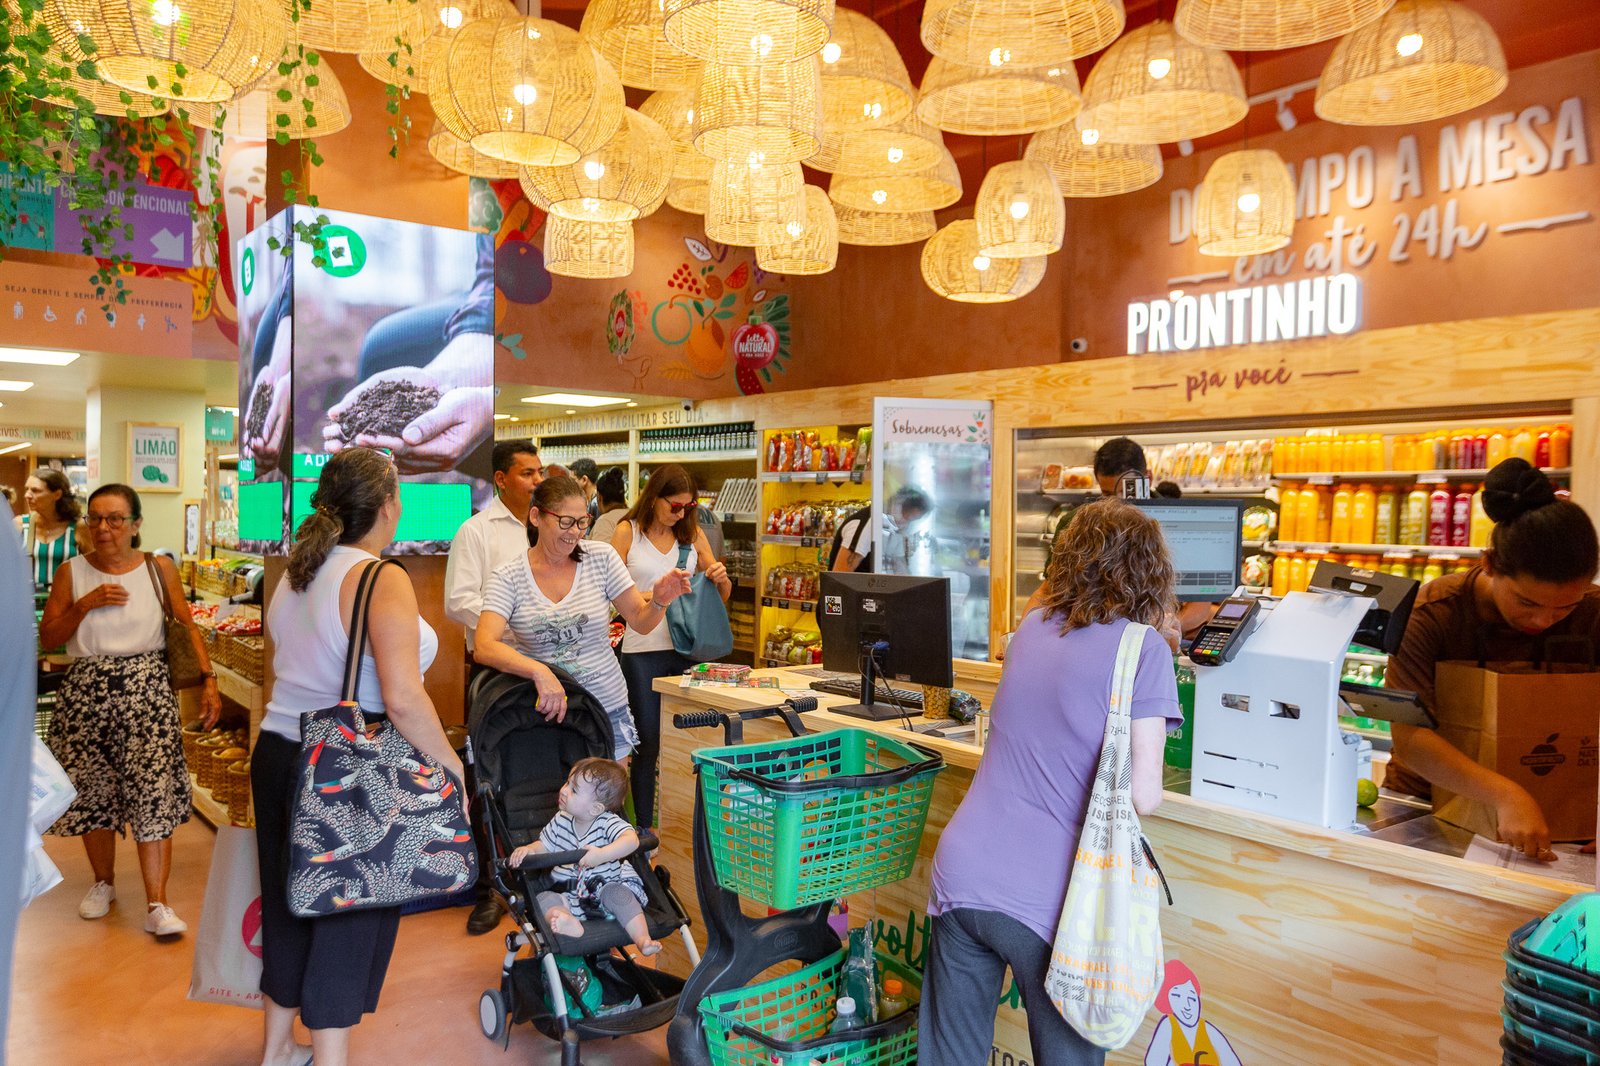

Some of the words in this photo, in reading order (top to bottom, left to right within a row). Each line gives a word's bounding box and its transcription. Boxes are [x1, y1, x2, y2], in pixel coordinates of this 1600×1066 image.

[1285, 146, 1375, 221] MPO
[1391, 135, 1423, 201] A
[1439, 96, 1590, 193] MESA
[1303, 216, 1377, 275] até
[1389, 198, 1489, 263] 24h
[5, 284, 27, 293] SEJA
[31, 287, 62, 297] GENTIL
[1127, 273, 1358, 355] PRONTINHO
[740, 341, 772, 353] NATURAL
[1185, 370, 1228, 401] pra
[1234, 358, 1292, 390] você
[0, 427, 22, 438] IVOS,
[529, 422, 546, 435] COM
[547, 419, 581, 434] CARINHO
[585, 416, 606, 430] PARA
[610, 412, 658, 429] FACILITAR
[662, 410, 681, 425] SEU
[892, 419, 964, 438] Sobremesas
[135, 436, 176, 456] LIMÃO
[209, 987, 232, 998] SITE
